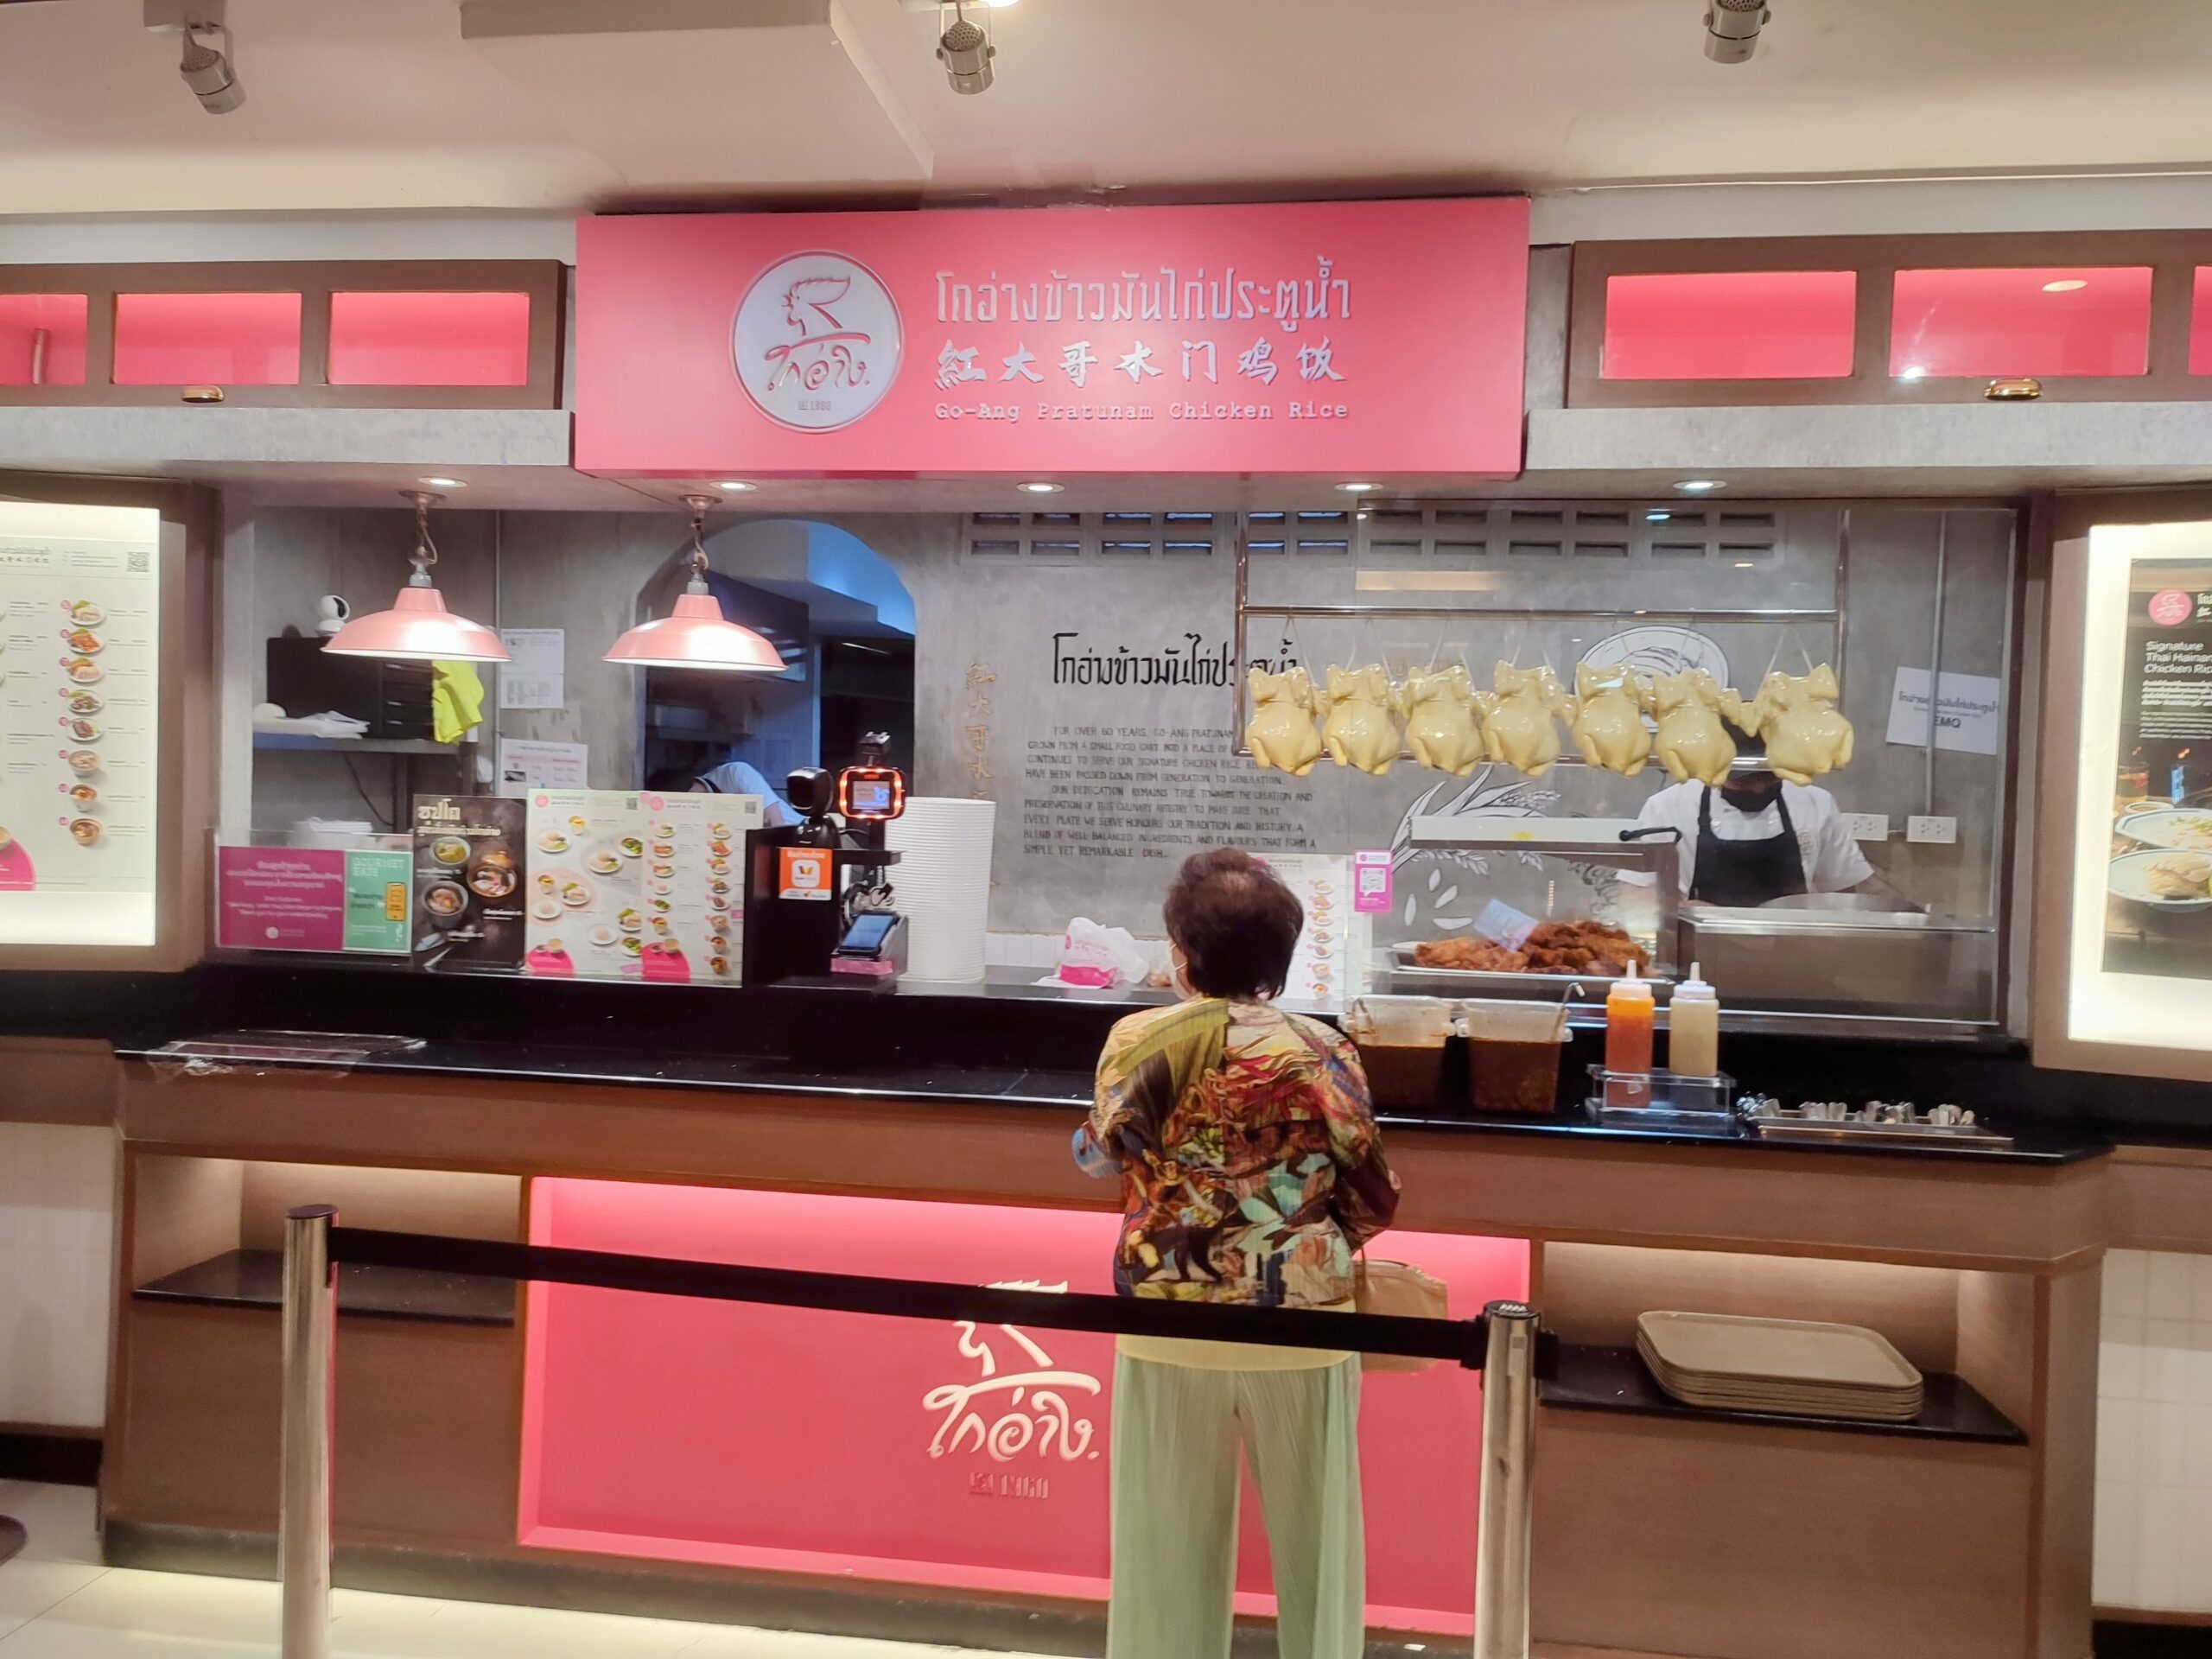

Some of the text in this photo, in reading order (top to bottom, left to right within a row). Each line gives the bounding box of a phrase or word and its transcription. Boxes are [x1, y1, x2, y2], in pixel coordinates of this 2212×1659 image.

[936, 254, 1351, 333] โกอ่างข้าวมันไก่ประตูน้ำ
[935, 400, 1349, 423] Go-Ang Pratunam Chicken Rice
[2145, 640, 2204, 653] Signature
[2145, 652, 2171, 663] Thai
[2144, 663, 2192, 674] Chicken
